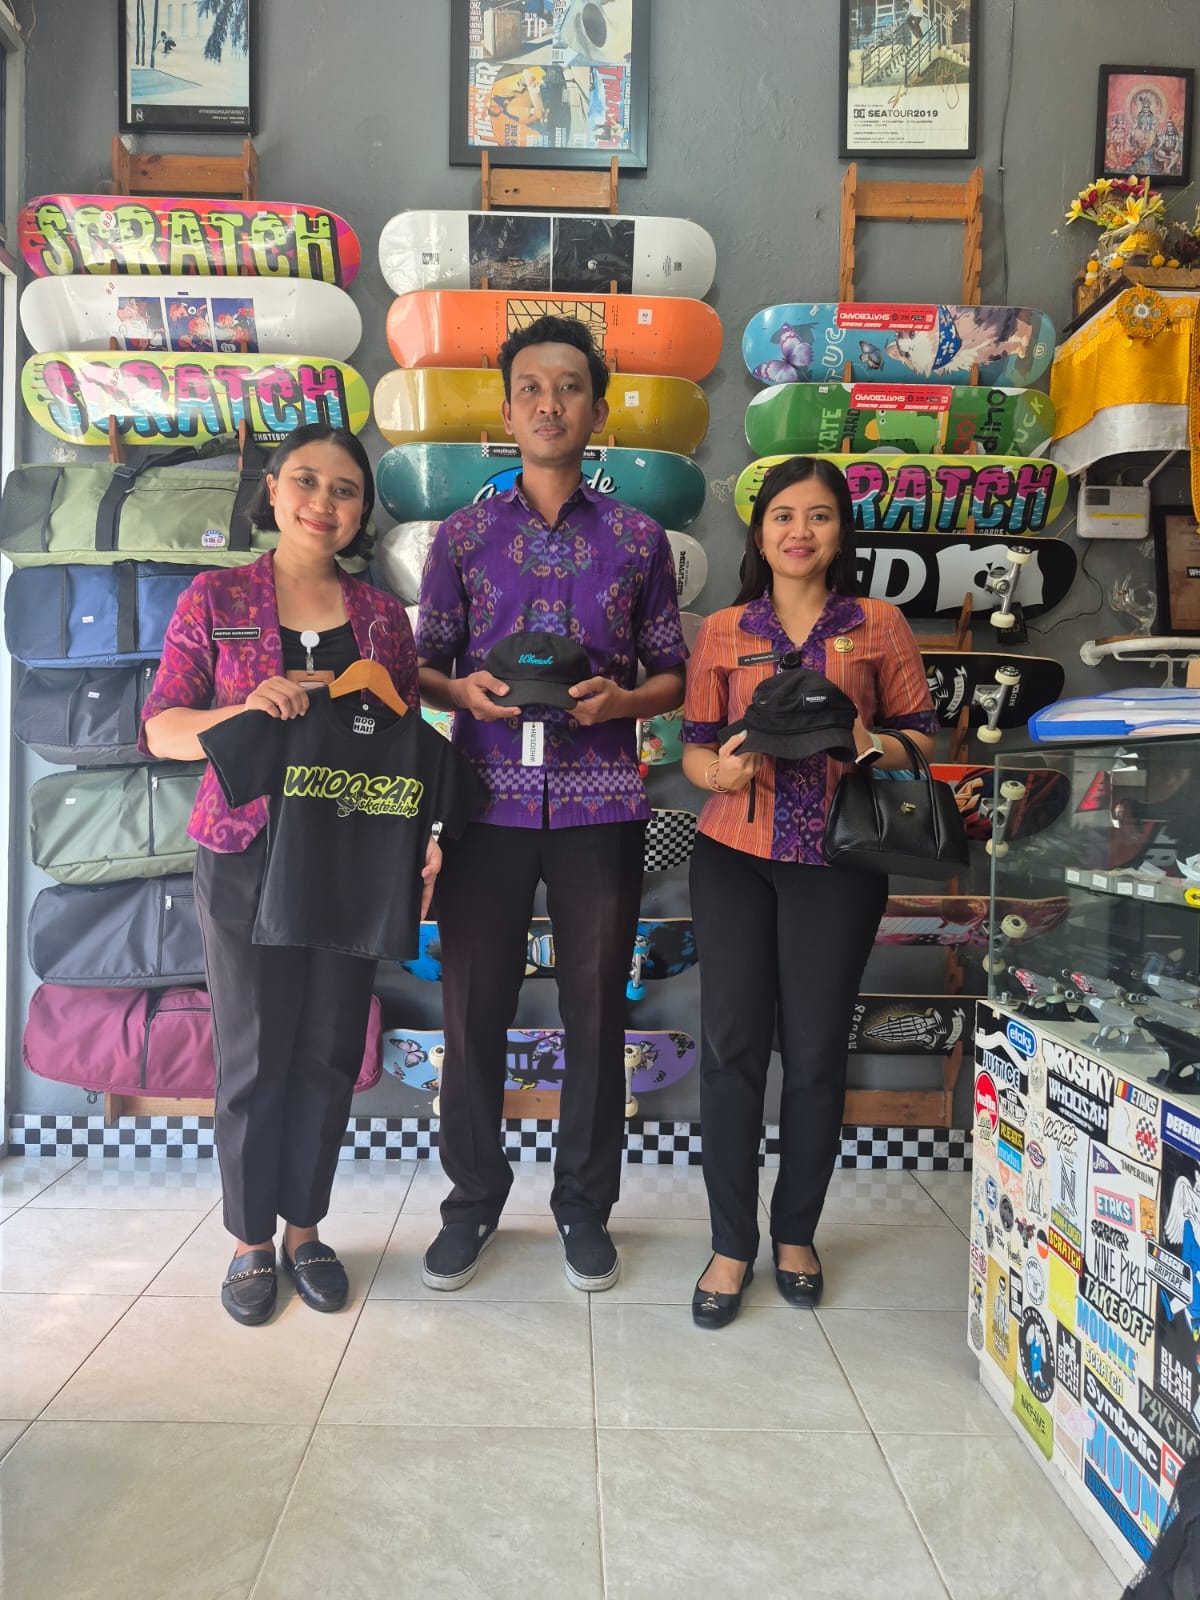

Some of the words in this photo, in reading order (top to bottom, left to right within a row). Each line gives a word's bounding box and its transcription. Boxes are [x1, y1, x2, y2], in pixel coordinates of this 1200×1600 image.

[867, 109, 939, 118] SEATOUR2019
[36, 203, 338, 285] SCRATCH
[43, 359, 347, 438] SCRATCH
[253, 433, 290, 441] SKATEBO
[846, 462, 1058, 535] RATCH
[353, 724, 374, 734] HAI!
[354, 716, 374, 726] BOO
[284, 766, 424, 806] WHOOSAH
[357, 797, 419, 818] skateshop
[1009, 1026, 1033, 1052] etaks
[982, 1050, 1019, 1089] JUSTICE
[1048, 1077, 1107, 1131] WHOOSAH
[1120, 1159, 1154, 1187] IMPERIUM
[1097, 1191, 1133, 1226] ETAKS
[1049, 1229, 1082, 1271] SCRATCH
[1154, 1262, 1184, 1289] GRIPTAPE
[1084, 1272, 1154, 1346] TAKEOFF
[1057, 1368, 1079, 1400] BLAH
[1085, 1345, 1124, 1399] SCRATCH
[1160, 1364, 1192, 1401] BLAH
[1161, 1346, 1192, 1387] BLAH
[1160, 1376, 1192, 1413] BLAH
[1086, 1373, 1159, 1471] Symbolic
